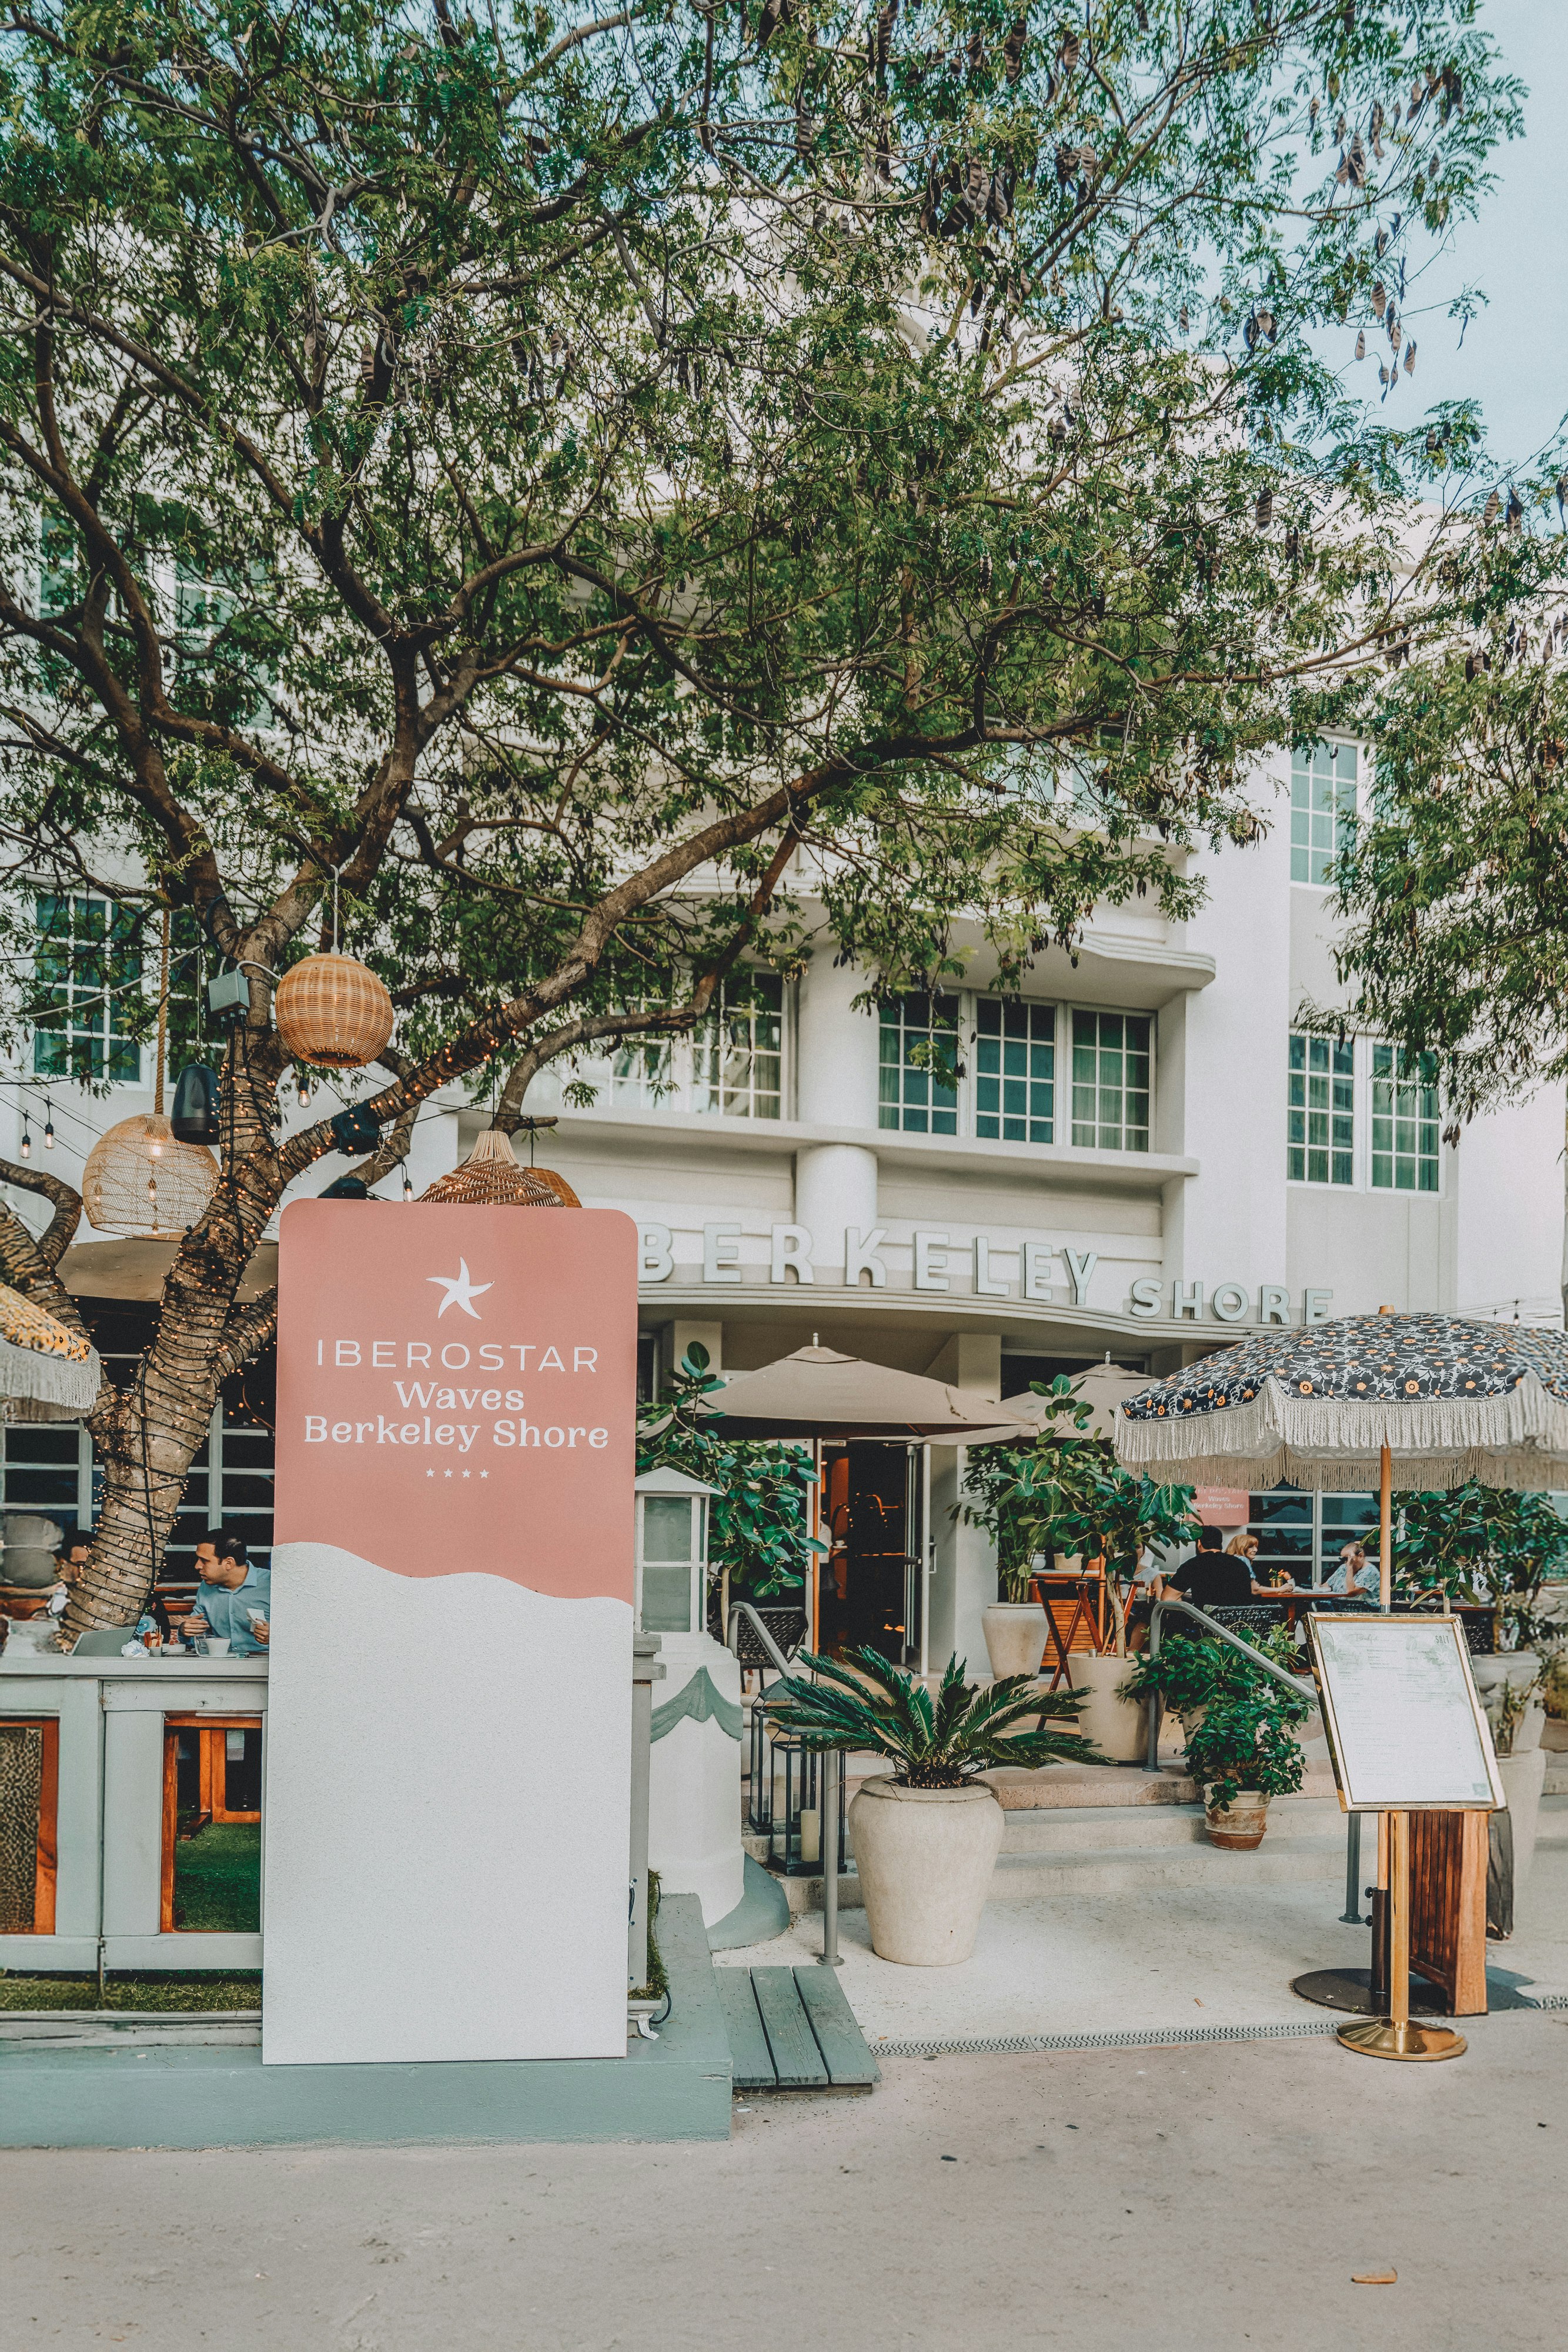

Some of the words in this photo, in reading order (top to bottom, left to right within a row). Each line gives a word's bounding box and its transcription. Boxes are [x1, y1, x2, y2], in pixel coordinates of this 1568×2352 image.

[638, 1222, 1098, 1305] BERKELEY
[1129, 1277, 1333, 1326] SHORE
[317, 1339, 599, 1373] IBEROSTAR
[393, 1381, 524, 1411] Waves
[304, 1415, 482, 1453] Berkeley
[493, 1418, 609, 1449] Shore
